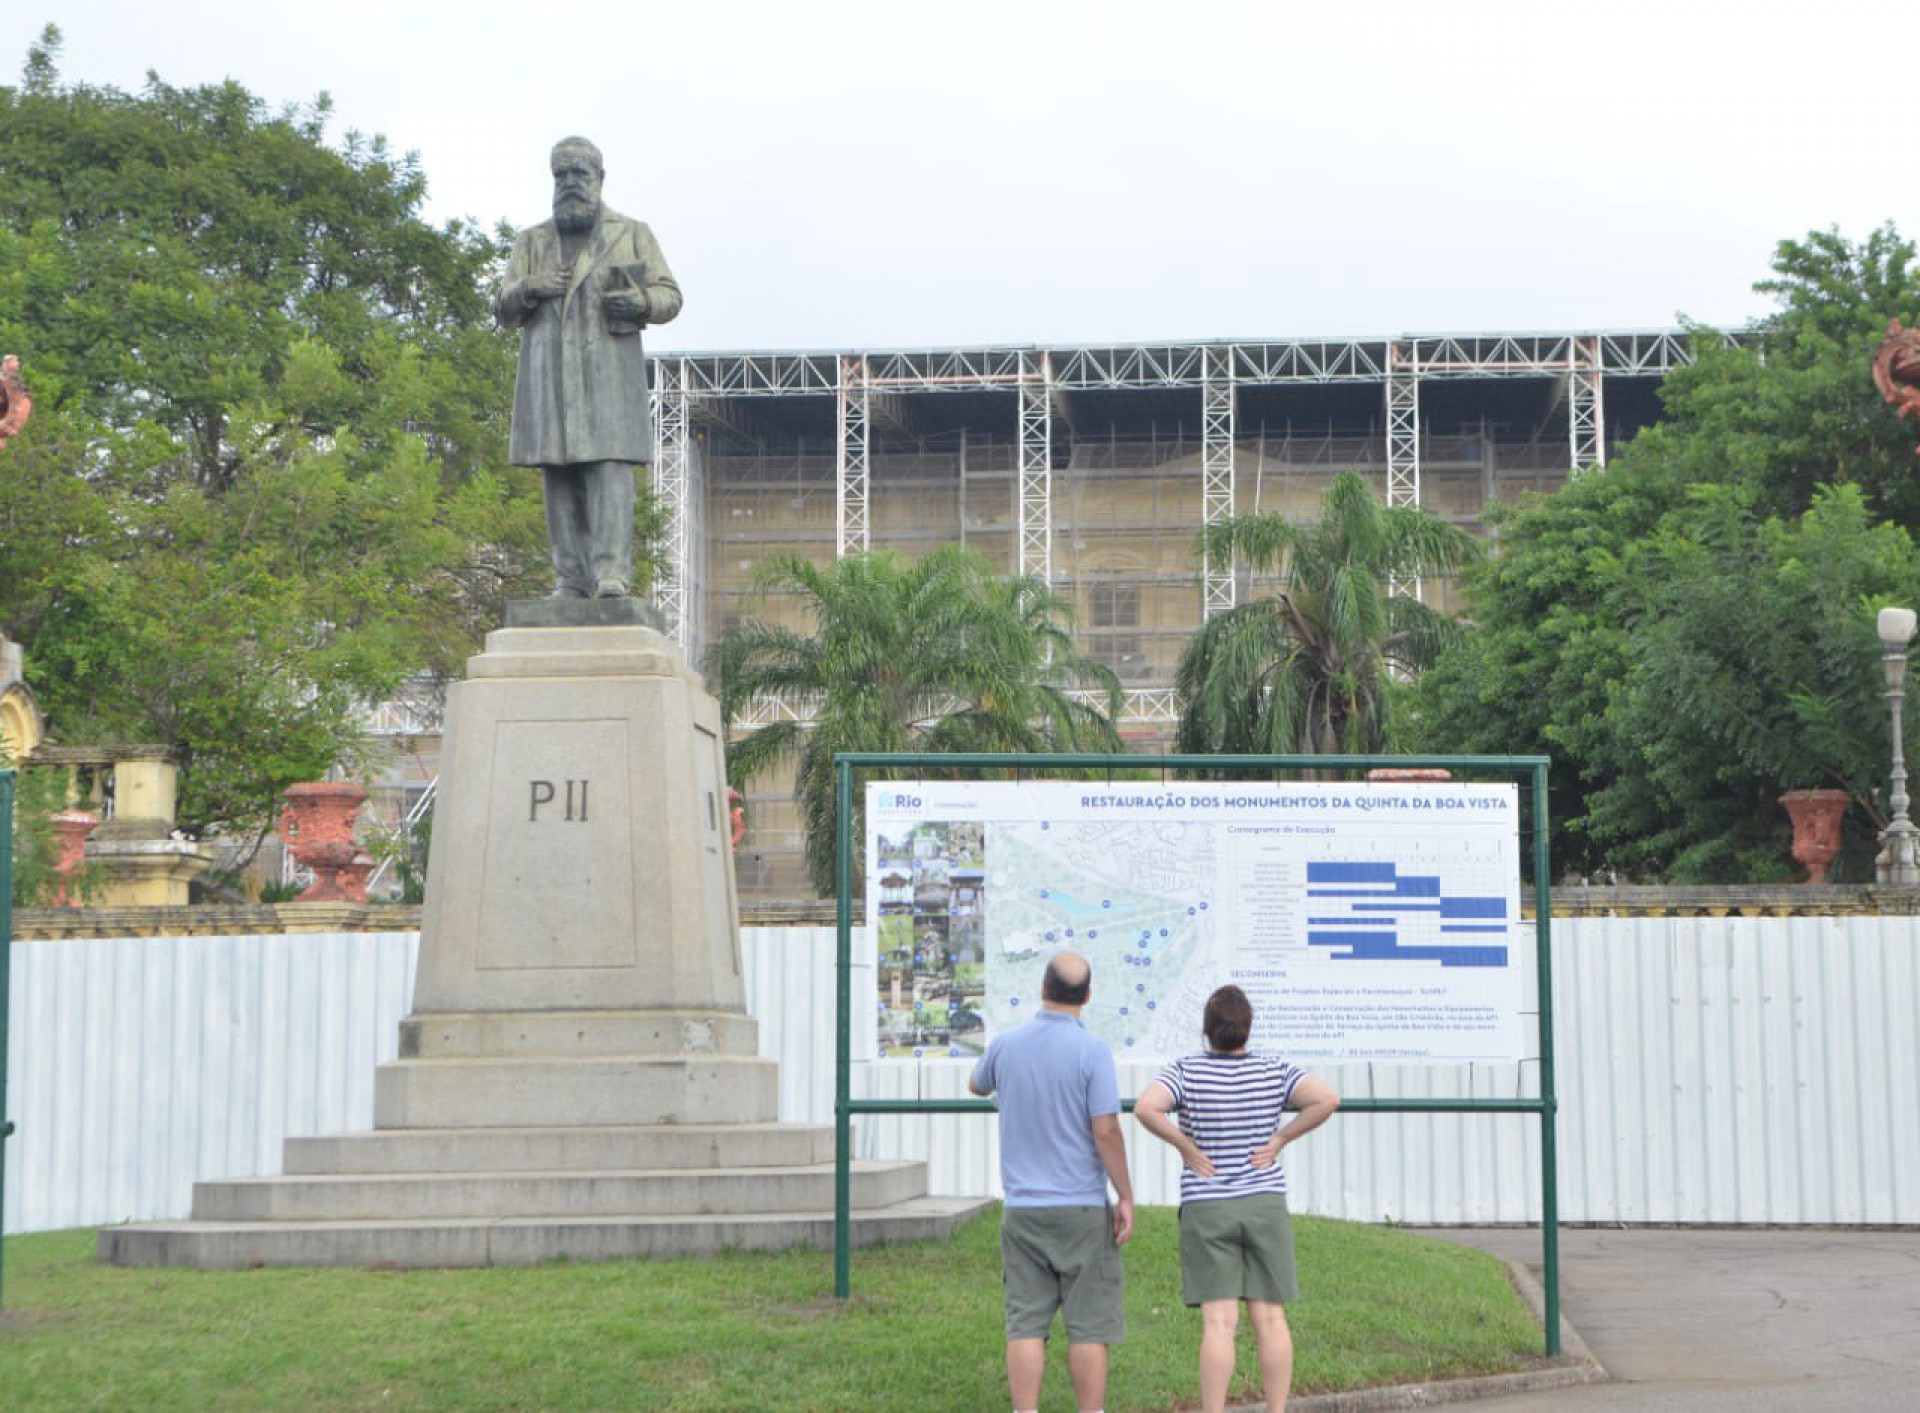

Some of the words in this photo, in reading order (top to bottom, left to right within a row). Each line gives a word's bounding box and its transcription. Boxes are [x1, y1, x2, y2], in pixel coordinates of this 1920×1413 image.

[895, 794, 922, 808] Rio
[1081, 792, 1186, 810] RESTAURAÇÃO
[1190, 796, 1220, 808] DOS
[1224, 796, 1328, 809] MONUMENTOS
[1332, 797, 1351, 809] DA
[1355, 797, 1409, 811] QUINTA
[1413, 797, 1432, 809] DA
[1436, 797, 1465, 809] BOA
[1468, 797, 1508, 809] VISTA
[1227, 825, 1281, 835] Cronograma
[1283, 825, 1294, 834] de
[1296, 825, 1336, 835] Execução
